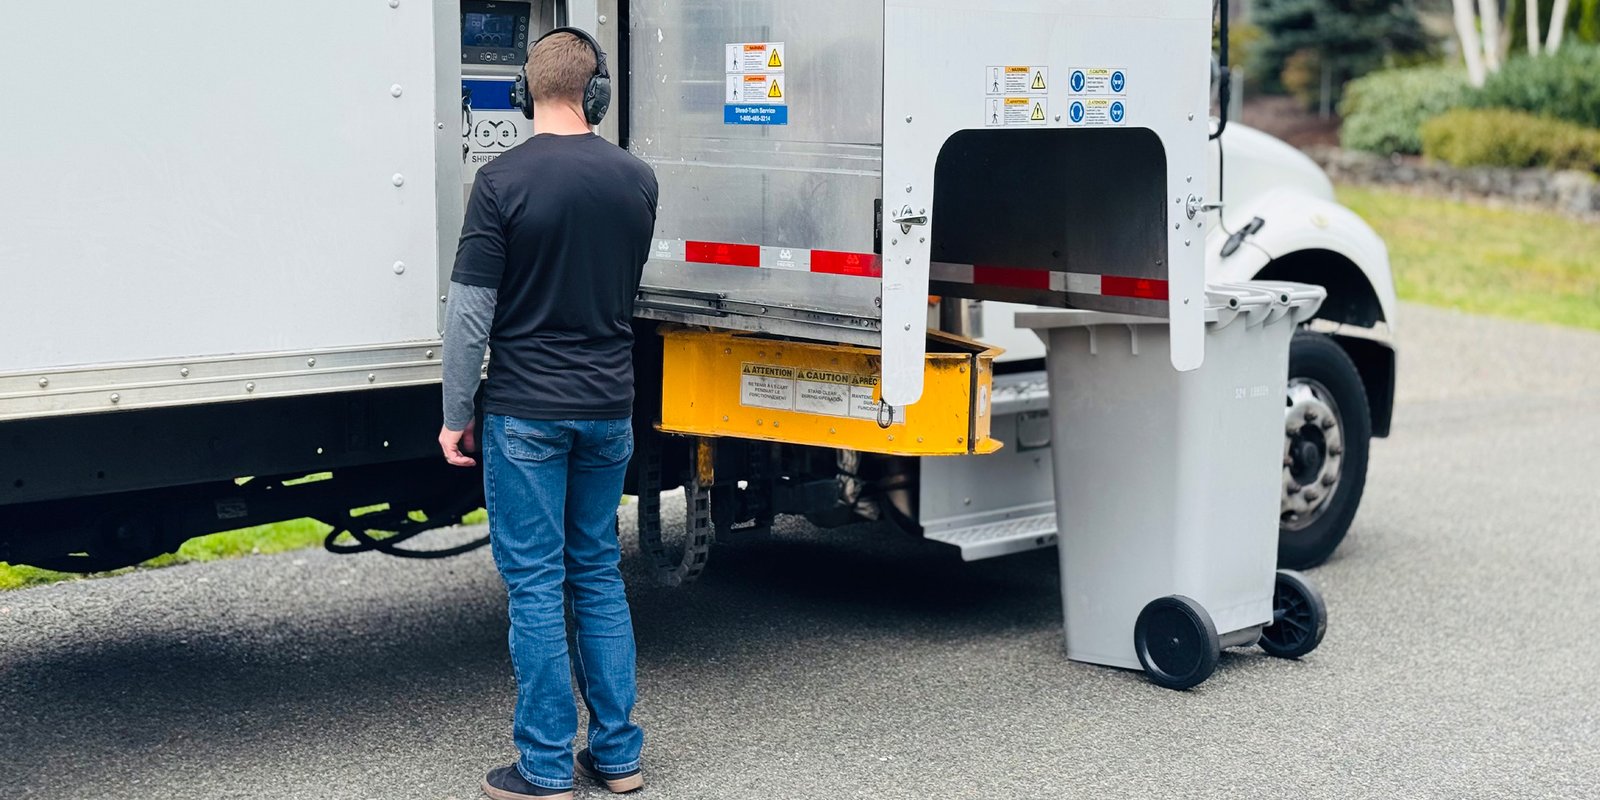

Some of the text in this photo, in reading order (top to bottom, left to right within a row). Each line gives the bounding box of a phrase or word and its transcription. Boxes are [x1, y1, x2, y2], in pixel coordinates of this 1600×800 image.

[752, 366, 792, 377] ATTENTION
[806, 371, 849, 383] CAUTION
[860, 376, 878, 386] PREC
